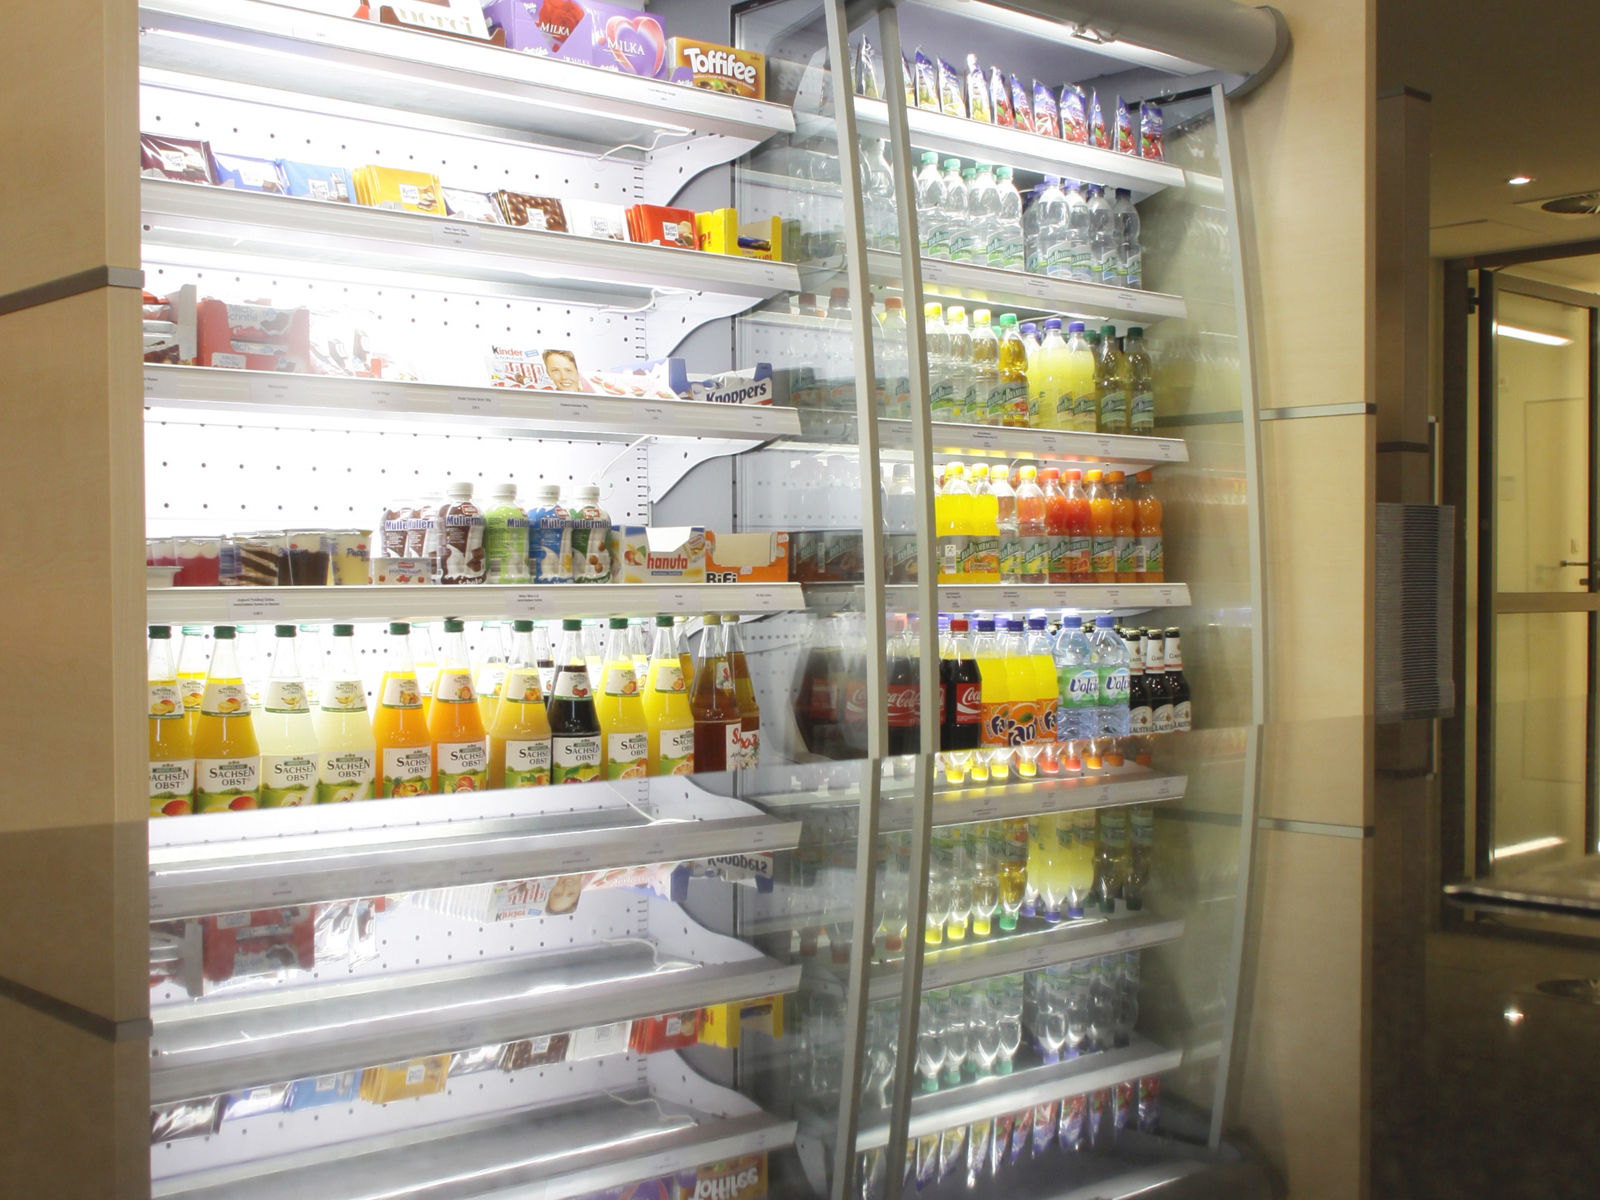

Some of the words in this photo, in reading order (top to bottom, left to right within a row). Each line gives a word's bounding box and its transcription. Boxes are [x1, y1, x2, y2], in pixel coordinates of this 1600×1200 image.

[540, 21, 571, 36] MILKA
[607, 38, 646, 56] MILKA
[683, 47, 757, 84] Toffifee
[706, 383, 767, 403] Knoppers
[647, 553, 688, 569] hanuta
[706, 572, 737, 583] BiFi
[529, 757, 548, 765] OBST
[575, 753, 597, 761] OBST
[327, 759, 371, 770] SACHSEN
[461, 759, 482, 767] OBST
[209, 768, 255, 779] SACHSEN
[274, 763, 317, 775] SACHSEN
[338, 768, 362, 777] OBST
[407, 766, 427, 774] OBST
[221, 777, 247, 786] OBST
[286, 772, 309, 782] OBST
[155, 781, 181, 790] OBST
